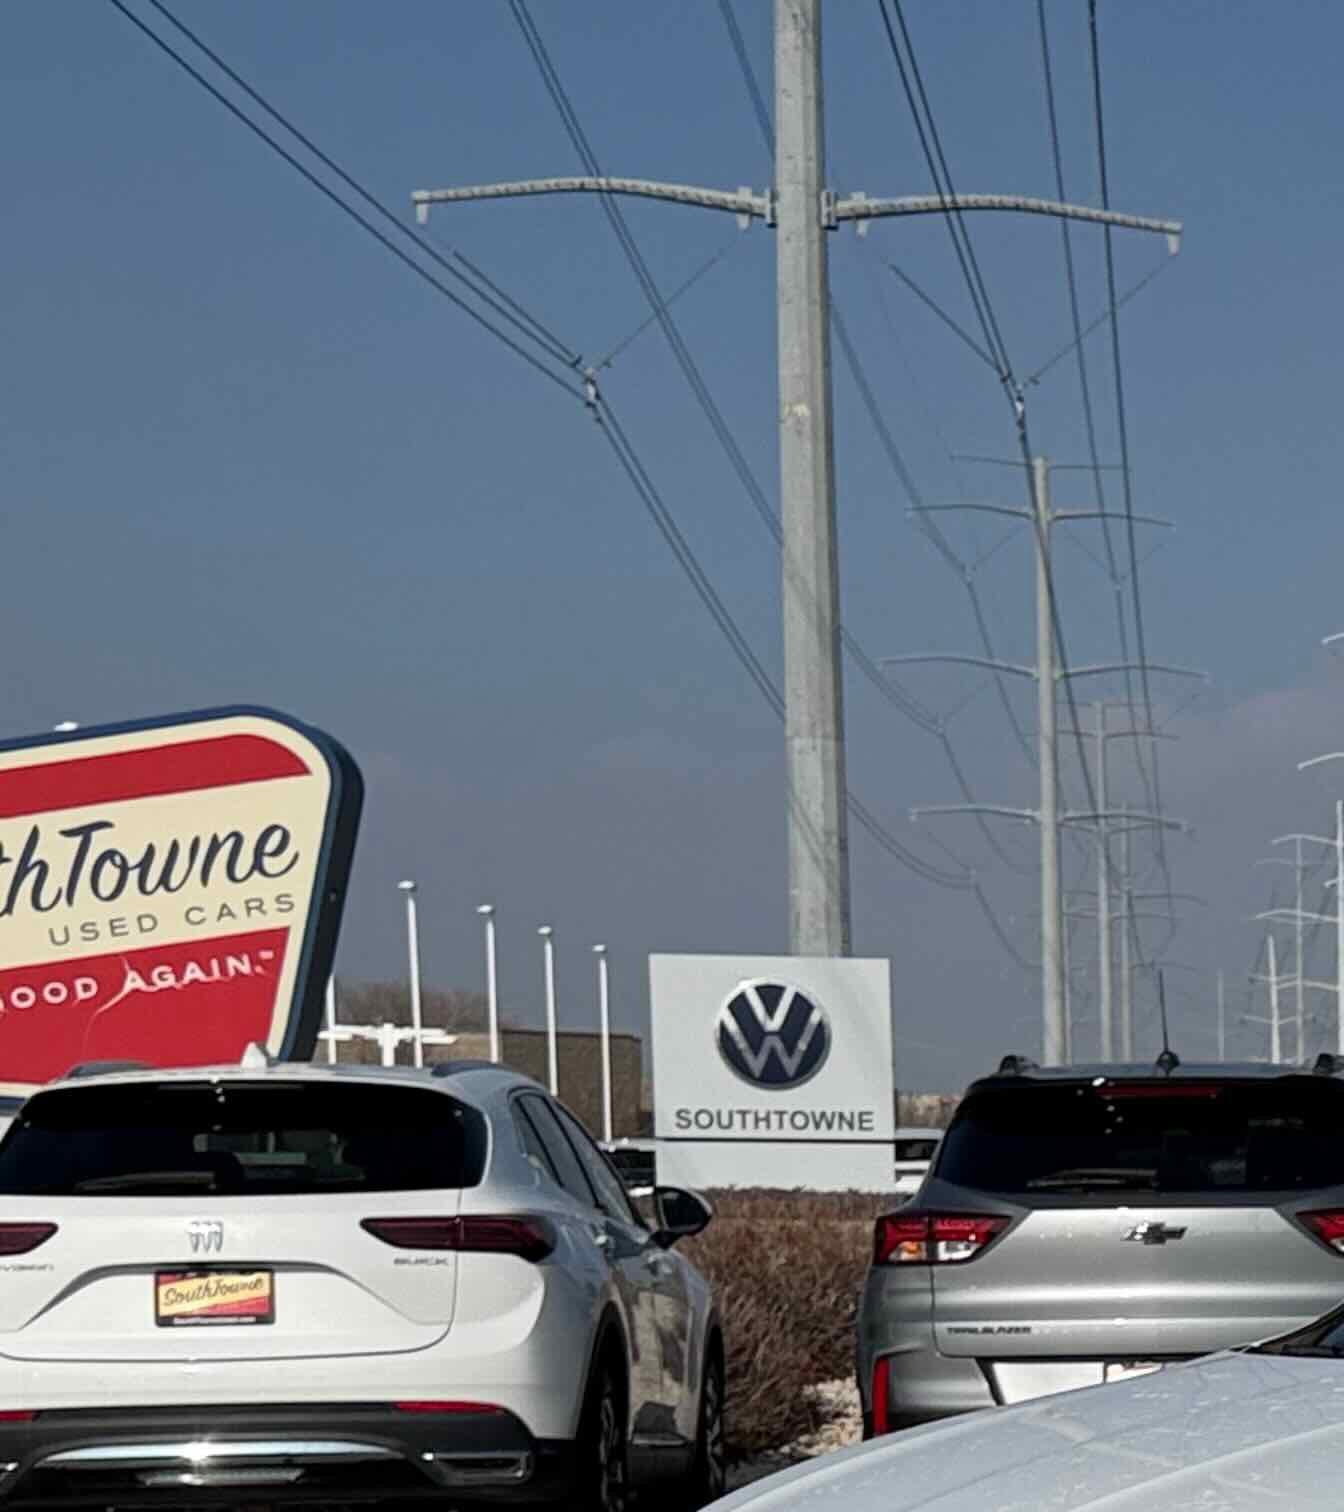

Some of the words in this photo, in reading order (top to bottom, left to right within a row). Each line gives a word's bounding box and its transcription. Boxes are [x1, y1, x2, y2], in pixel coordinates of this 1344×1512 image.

[48, 913, 158, 946] USED
[184, 893, 295, 925] CARS
[0, 976, 98, 1011] OOD
[717, 979, 829, 1086] VW
[674, 1108, 874, 1131] SOUTHTOWNE
